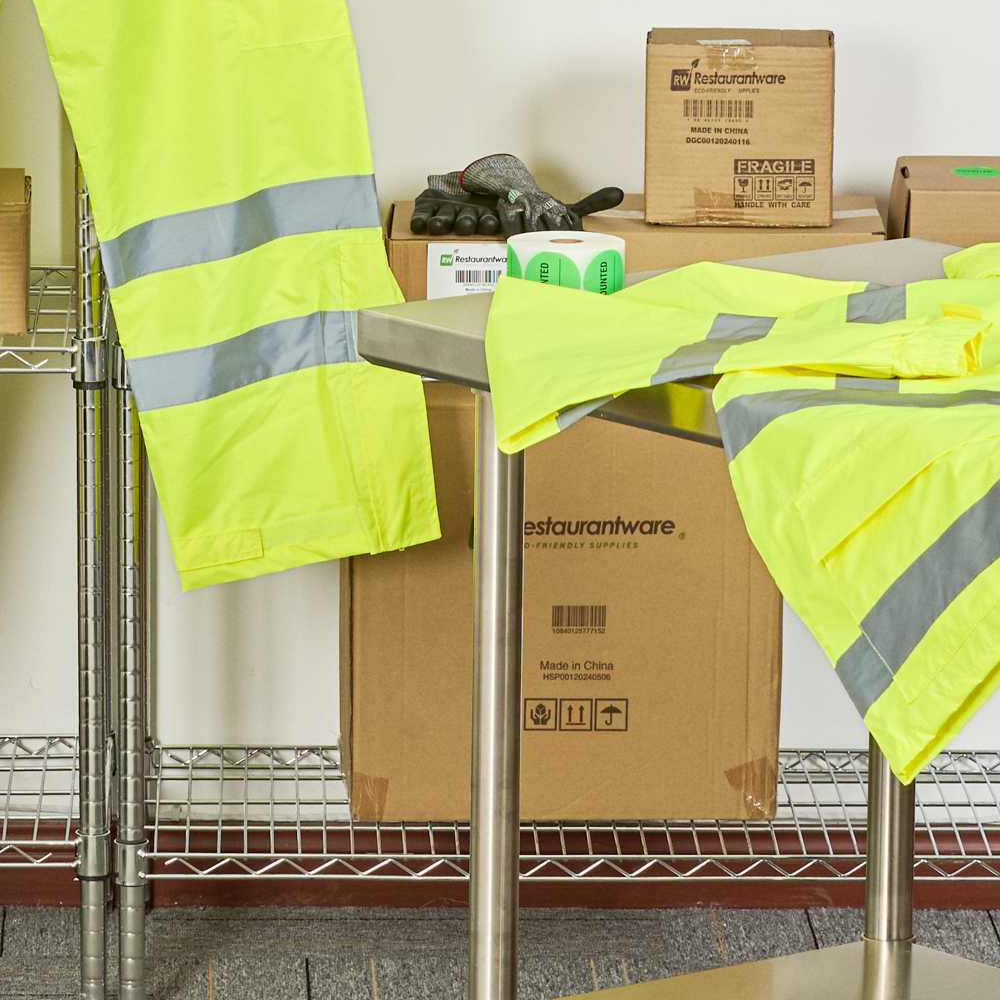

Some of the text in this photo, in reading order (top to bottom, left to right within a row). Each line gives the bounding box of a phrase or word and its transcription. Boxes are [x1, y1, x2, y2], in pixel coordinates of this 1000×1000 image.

[673, 74, 690, 86] RW
[694, 71, 786, 85] Restaurantware
[737, 161, 813, 173] FRAGILE
[524, 516, 675, 536] estaurantware
[589, 541, 639, 549] SUPPLIES
[539, 660, 614, 670] Made in China
